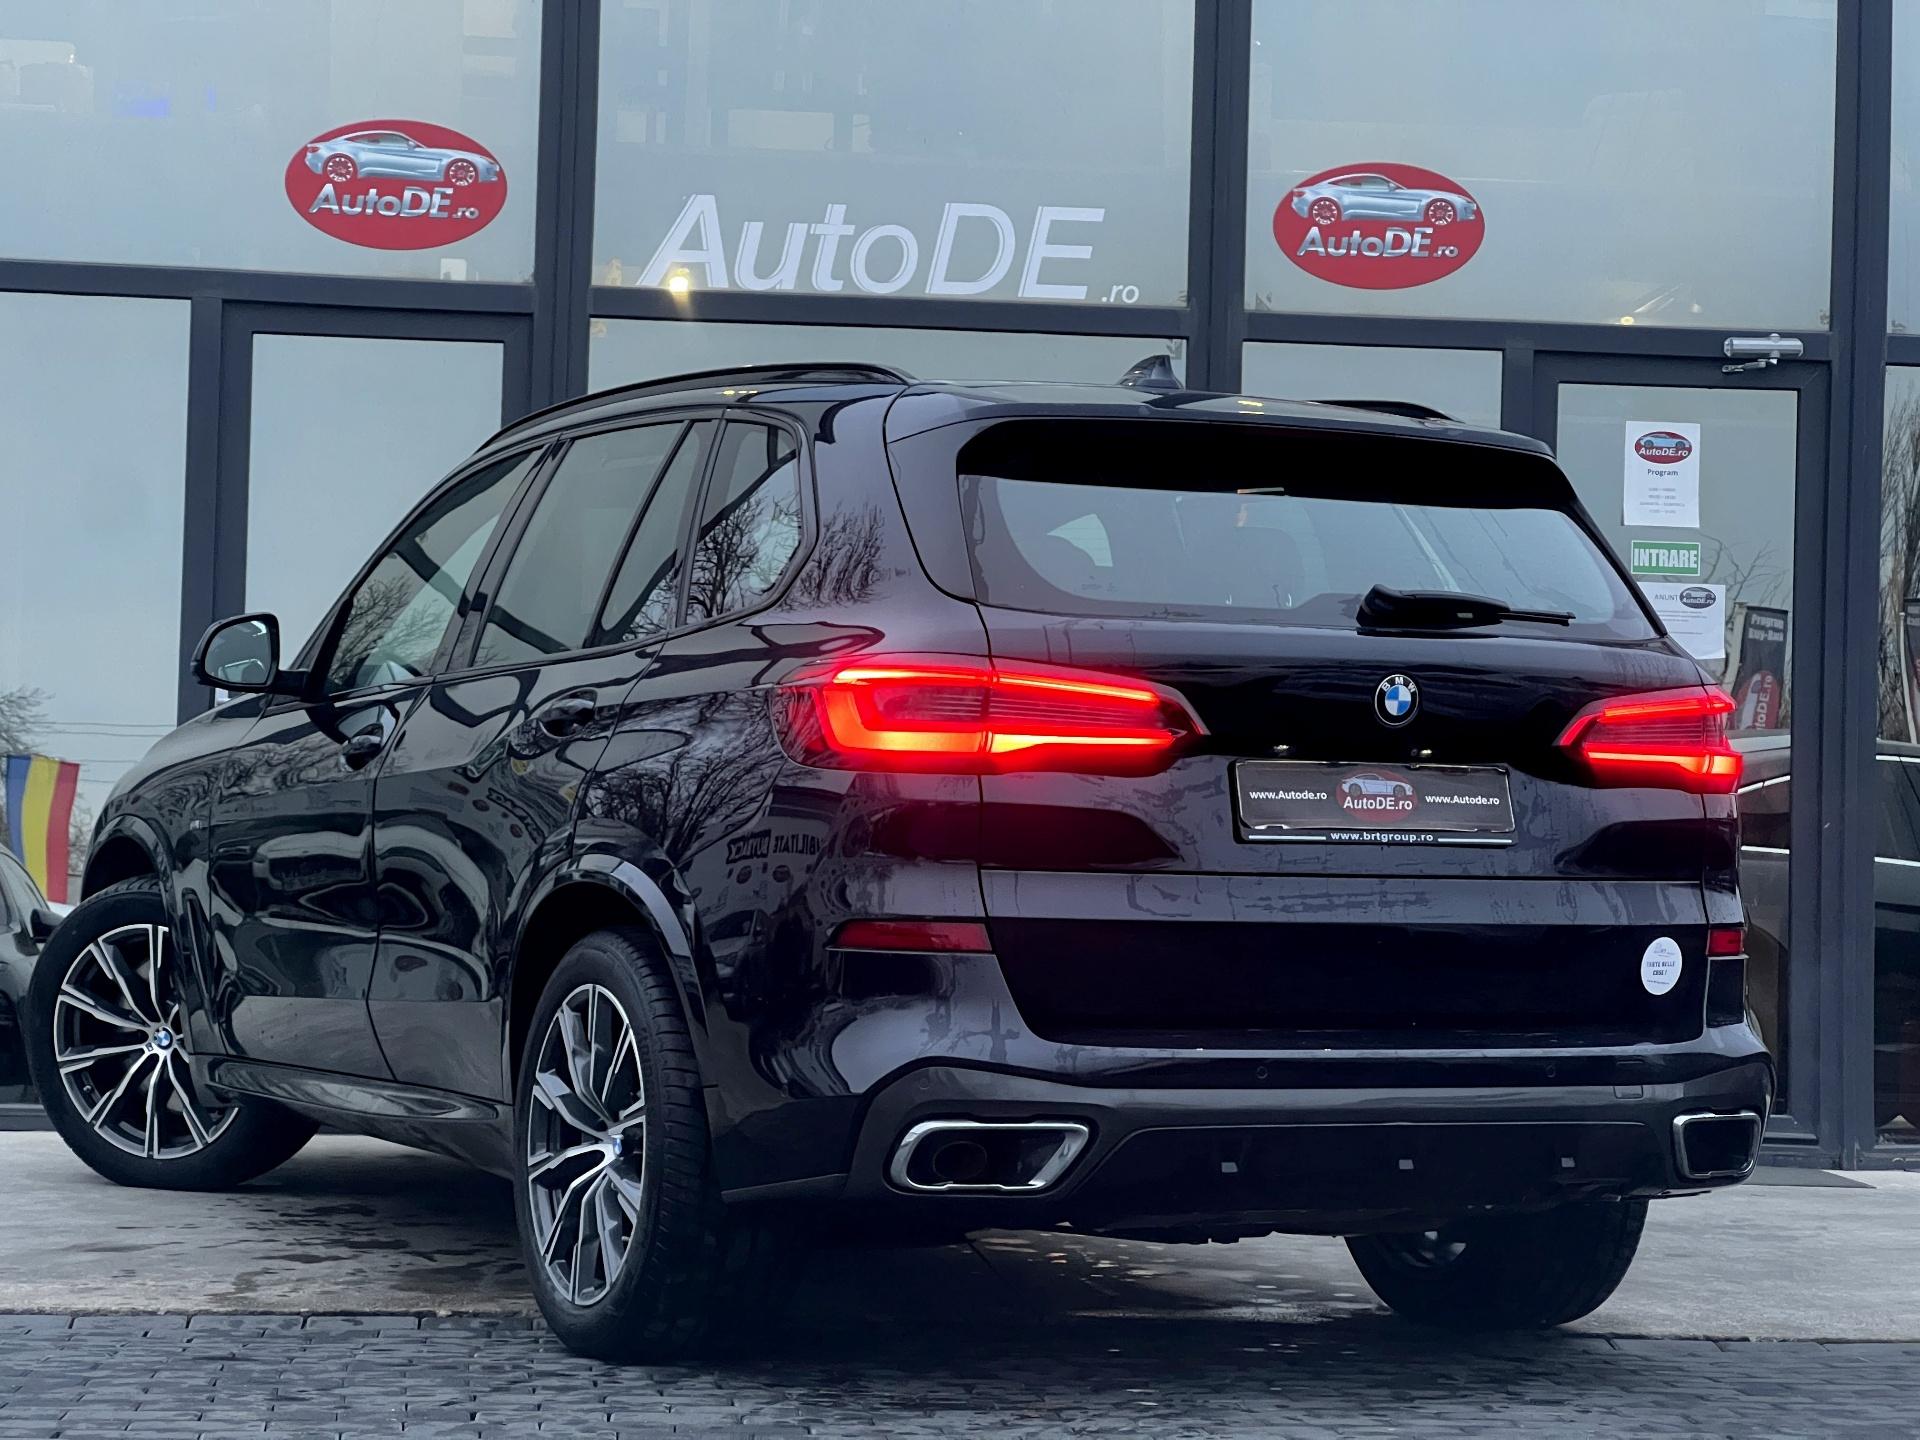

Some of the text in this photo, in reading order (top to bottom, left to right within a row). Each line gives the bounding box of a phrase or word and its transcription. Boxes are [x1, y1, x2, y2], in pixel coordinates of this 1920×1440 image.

[1647, 468, 1679, 477] Program
[1633, 548, 1698, 569] INTRARE
[1249, 790, 1500, 810] www.Autode.ro AutoDE.ro www.Autode.ro
[1330, 831, 1434, 843] www.brtgroup.ro
